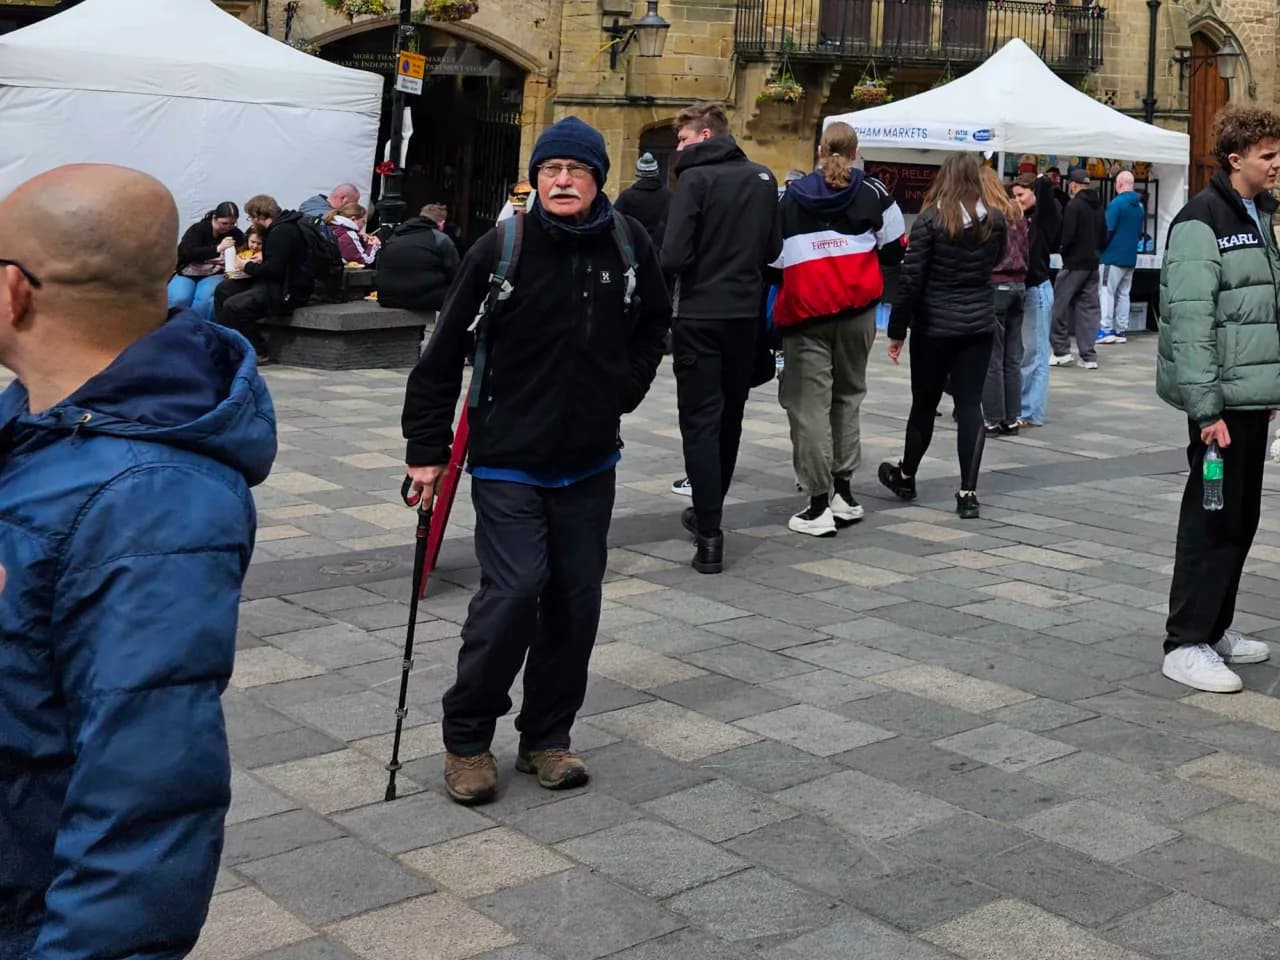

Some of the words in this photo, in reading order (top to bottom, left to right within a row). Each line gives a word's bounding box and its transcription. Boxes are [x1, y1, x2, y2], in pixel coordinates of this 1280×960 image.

[883, 128, 928, 139] MARKETS
[811, 239, 849, 250] Ferrari
[1217, 233, 1258, 249] KARL
